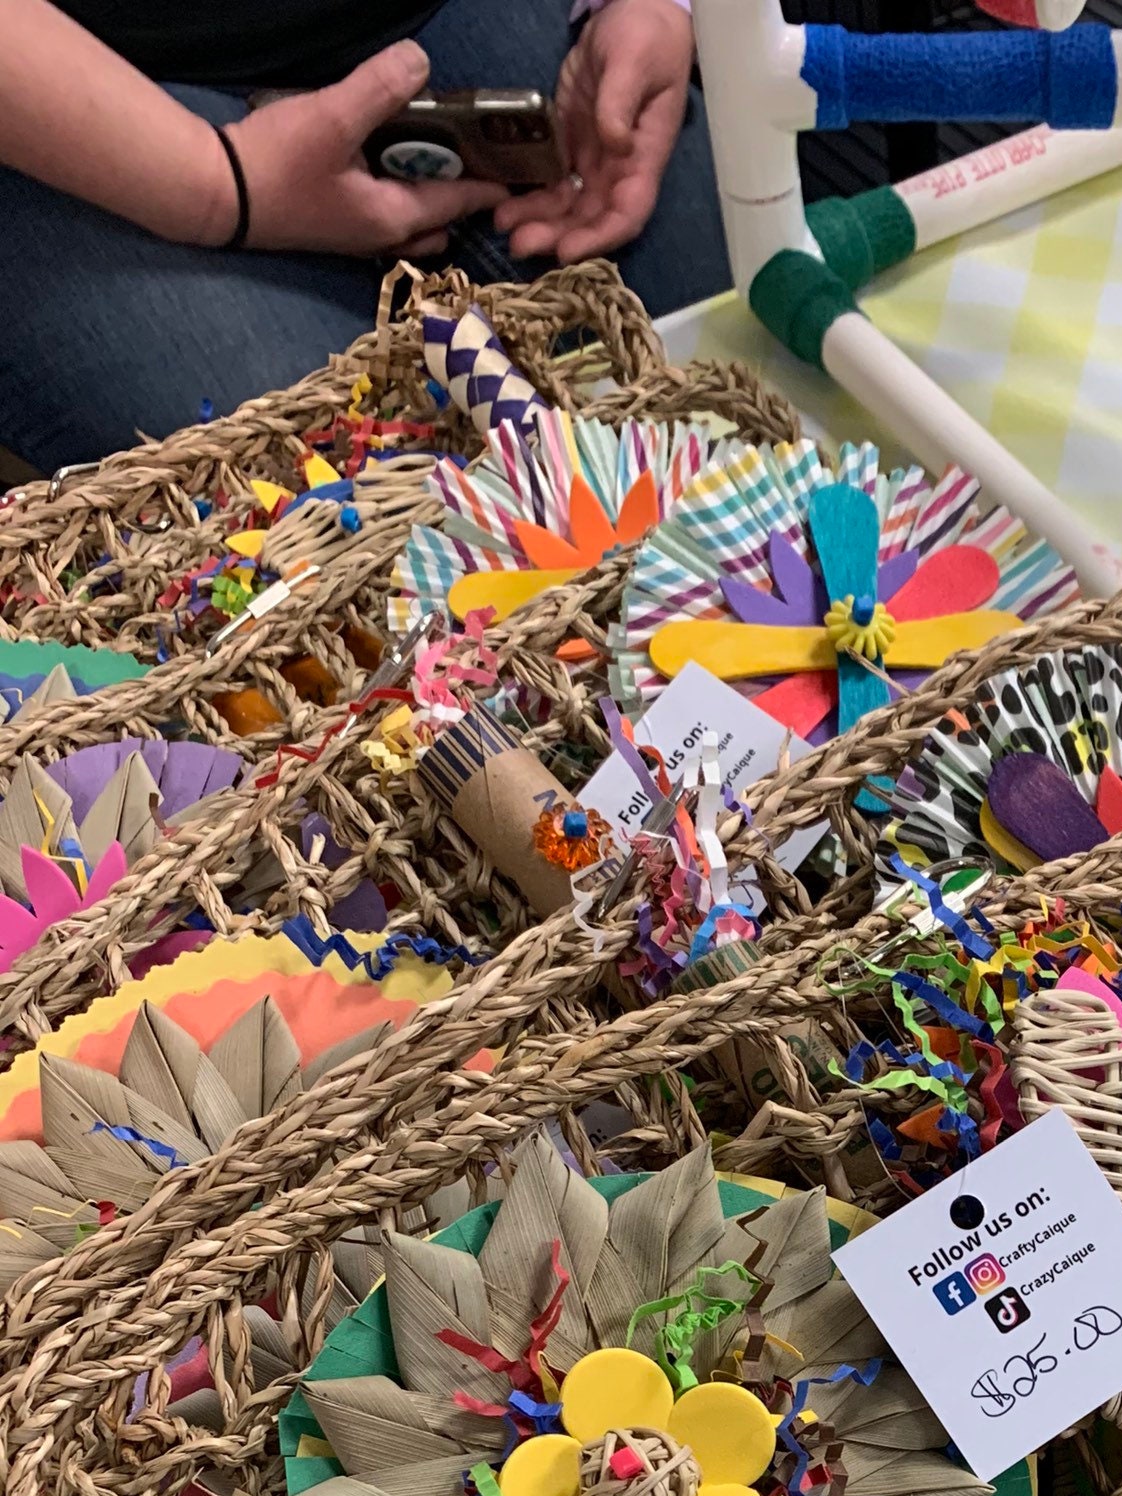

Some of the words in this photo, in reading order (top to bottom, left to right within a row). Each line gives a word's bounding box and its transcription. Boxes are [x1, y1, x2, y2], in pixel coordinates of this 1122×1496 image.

[665, 750, 685, 771] us
[683, 720, 708, 749] on:
[908, 1230, 983, 1287] Follow
[984, 1211, 1013, 1239] us
[1014, 1185, 1052, 1219] on:
[999, 1211, 1077, 1269] CraftyCaique
[1020, 1240, 1096, 1297] CrazyCaique
